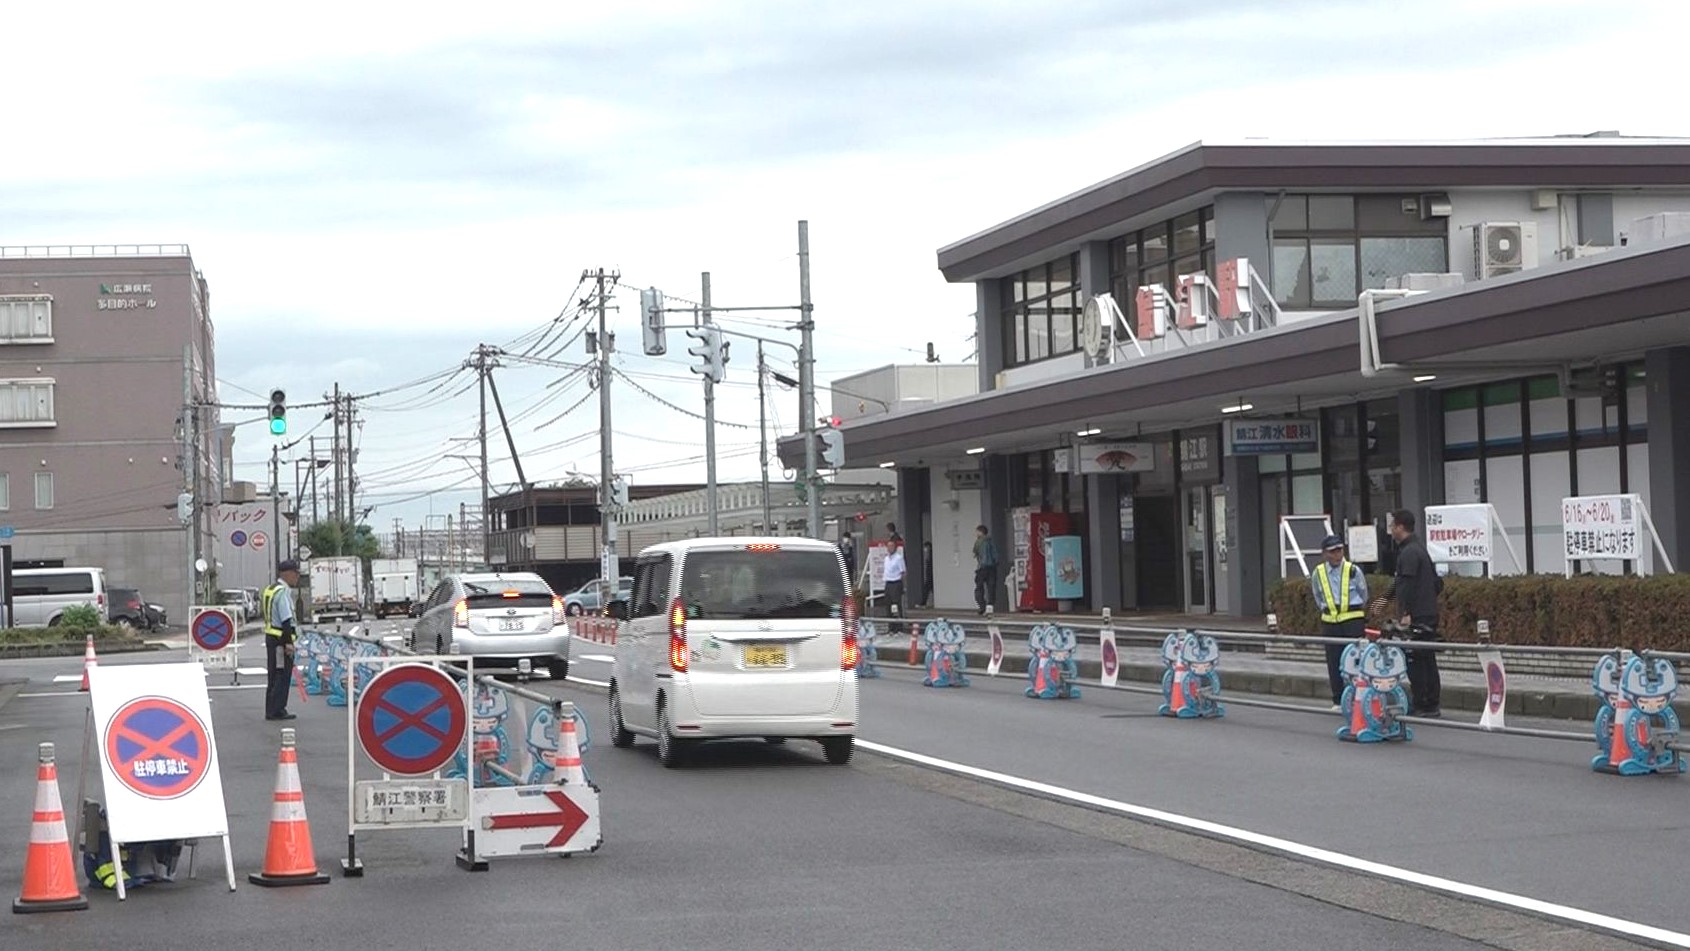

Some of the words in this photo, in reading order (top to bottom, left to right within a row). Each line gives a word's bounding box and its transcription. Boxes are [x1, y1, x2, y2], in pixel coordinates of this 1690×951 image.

[97, 299, 157, 310] 多目的ホール
[1236, 425, 1311, 440] 鯖江清水眼科
[1566, 526, 1635, 555] 駐停車禁止になります
[133, 757, 190, 777] 駐停車禁止
[372, 790, 447, 806] 鯖江警察署
